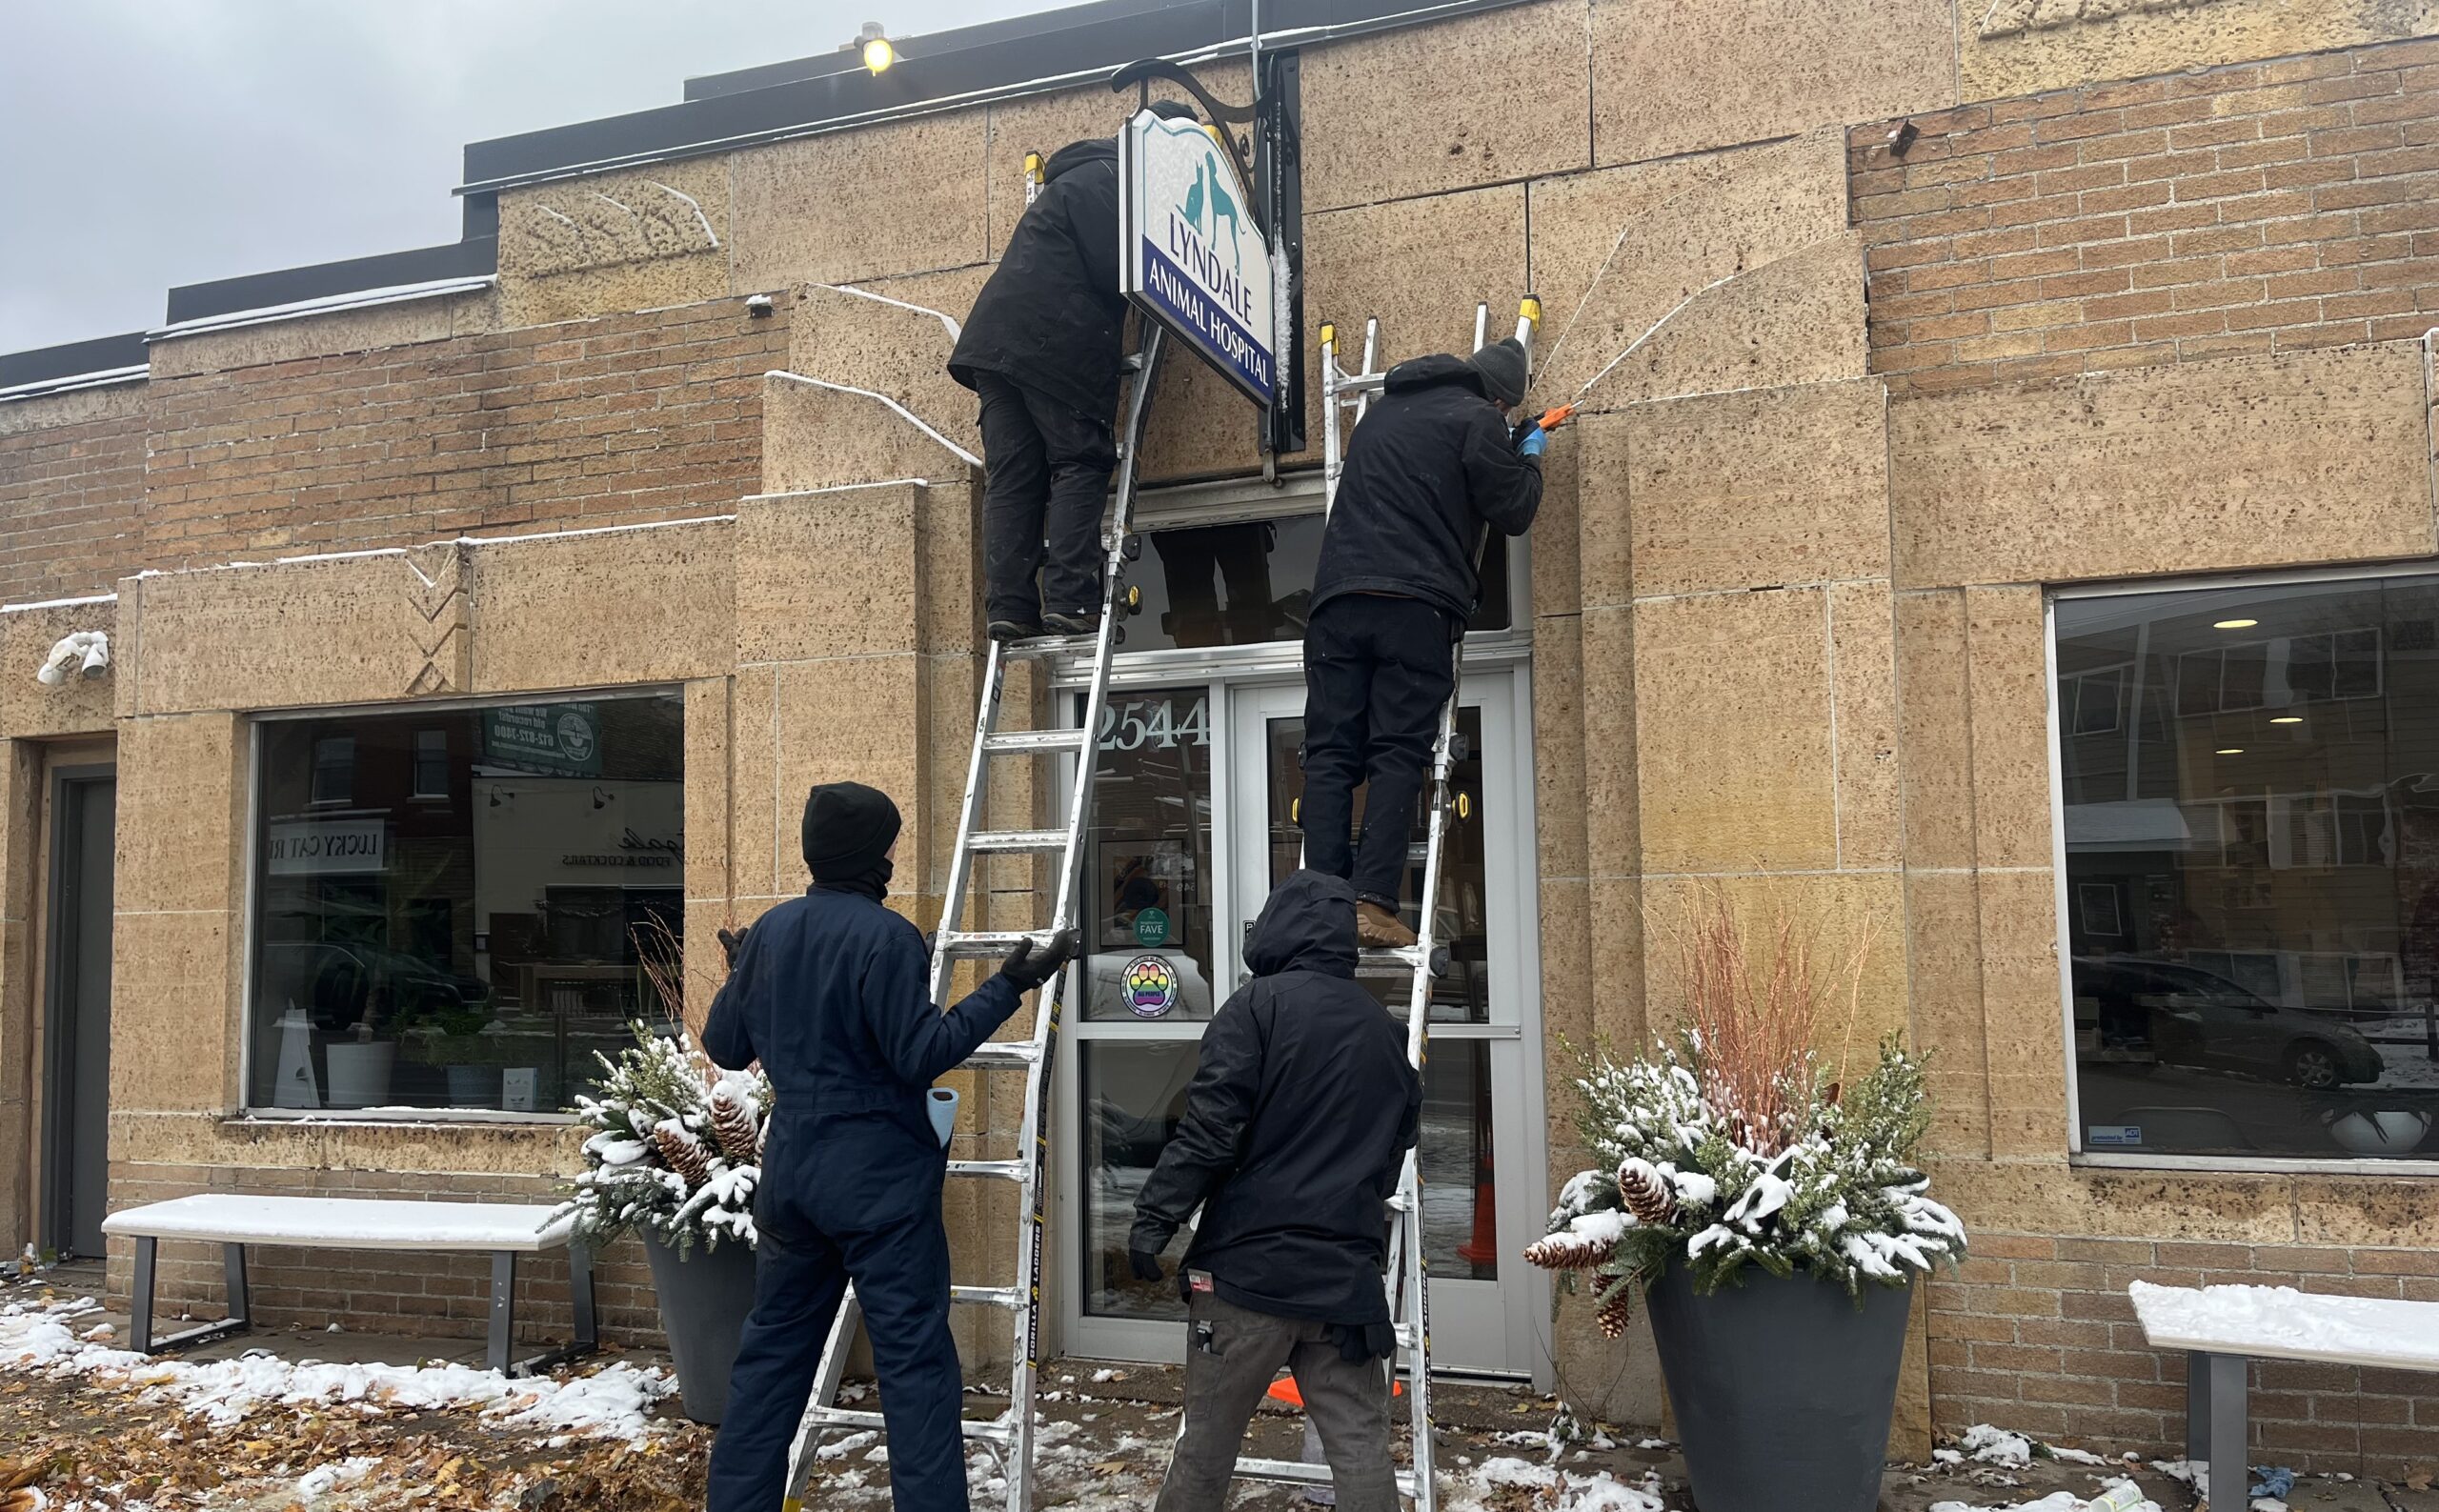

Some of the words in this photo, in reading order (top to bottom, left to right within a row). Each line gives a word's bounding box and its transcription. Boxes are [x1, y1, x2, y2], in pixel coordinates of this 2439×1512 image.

[1170, 212, 1252, 327] LYNDALE
[1149, 258, 1206, 333] ANIMAL
[1210, 311, 1269, 387] HOSPITAL
[1099, 697, 1210, 751] 2544
[1139, 924, 1163, 934] FAVE
[1033, 1225, 1041, 1282] LADDERS
